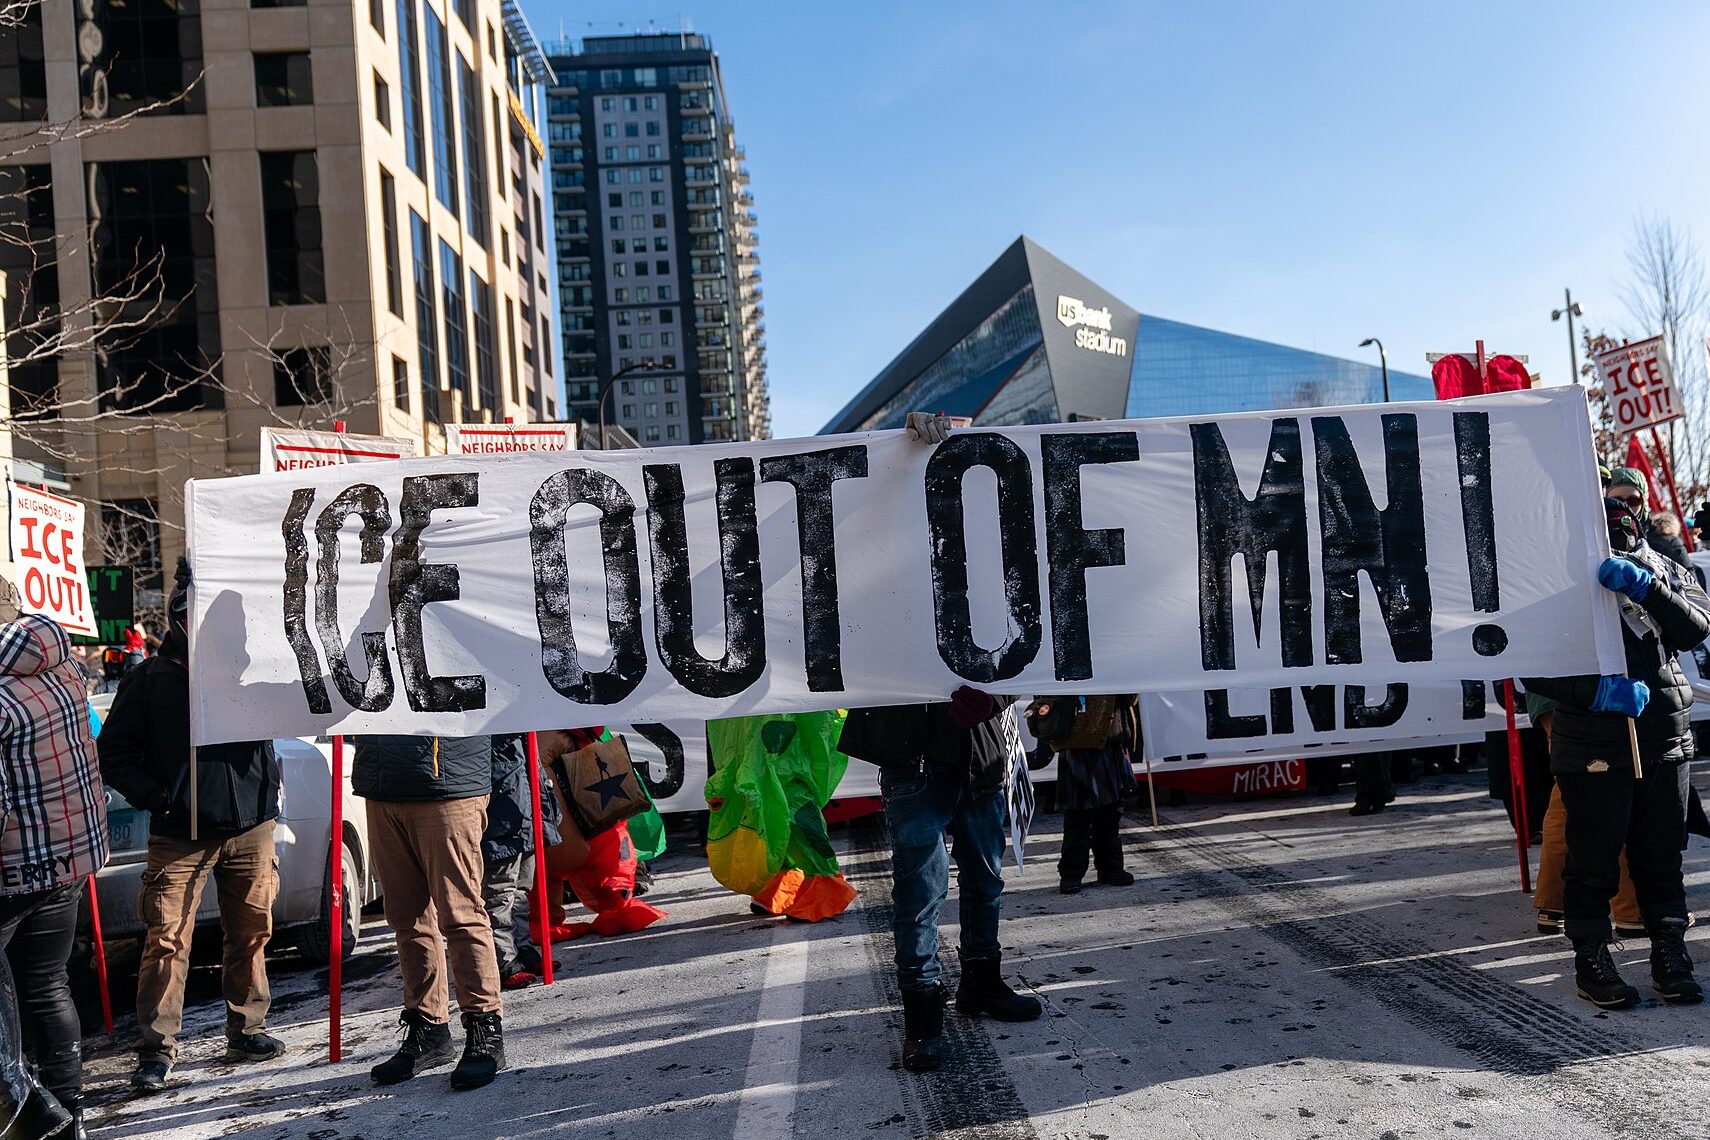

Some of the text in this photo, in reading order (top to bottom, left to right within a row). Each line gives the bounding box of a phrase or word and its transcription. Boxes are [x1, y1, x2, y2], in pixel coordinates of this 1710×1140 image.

[1075, 327, 1127, 356] stadium
[1607, 357, 1663, 397] ICE
[1618, 386, 1672, 425] OUT!
[20, 517, 77, 574] ICE
[281, 411, 1509, 713] ICE OUT OF MN!
[25, 566, 84, 623] OUT!
[1233, 760, 1301, 793] MIRAC
